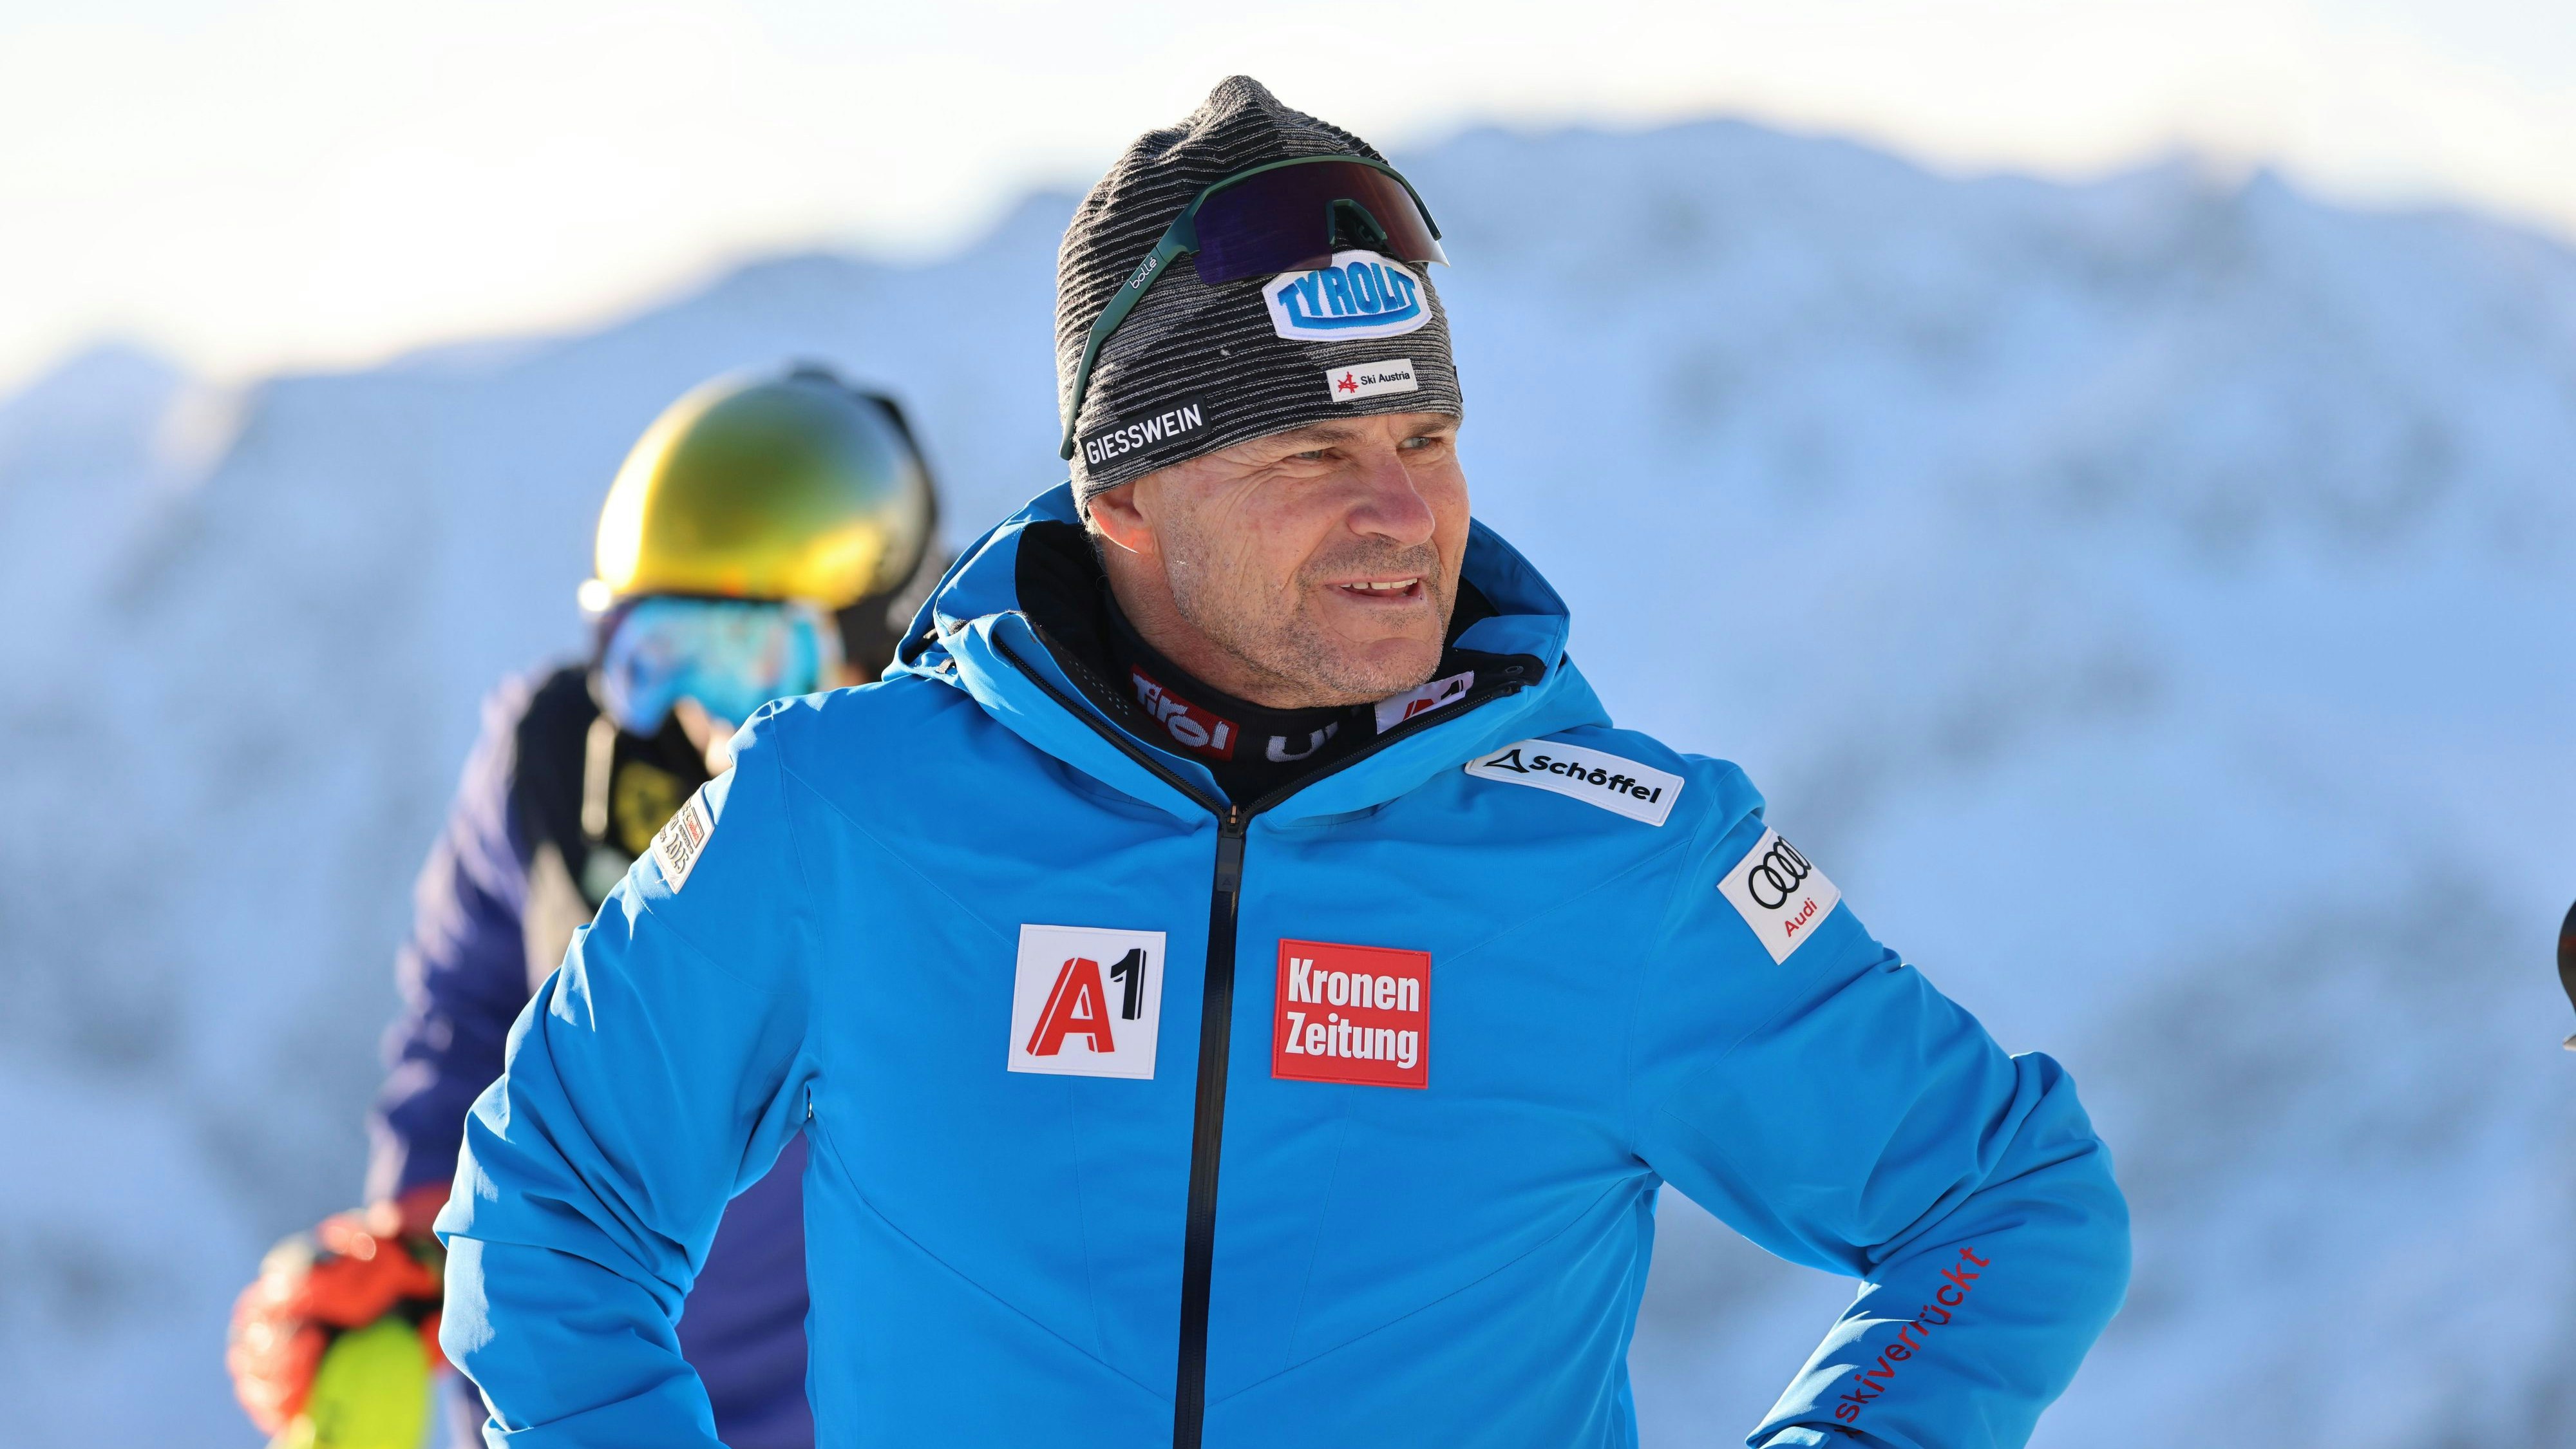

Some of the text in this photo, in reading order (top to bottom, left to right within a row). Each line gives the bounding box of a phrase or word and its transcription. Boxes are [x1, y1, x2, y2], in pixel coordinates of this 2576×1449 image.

[1129, 257, 1157, 289] bollé
[1278, 260, 1417, 317] TYROLIT
[1360, 371, 1410, 385] Ski Austria
[1086, 402, 1203, 465] GIESSWEIN
[663, 833, 689, 874] 2025
[1783, 896, 1818, 938] Audi
[1025, 947, 1148, 1057] A1
[1287, 957, 1420, 1012] Kronen
[1284, 1012, 1419, 1069] Zeitung
[1834, 1246, 1991, 1423] skiverrückt
